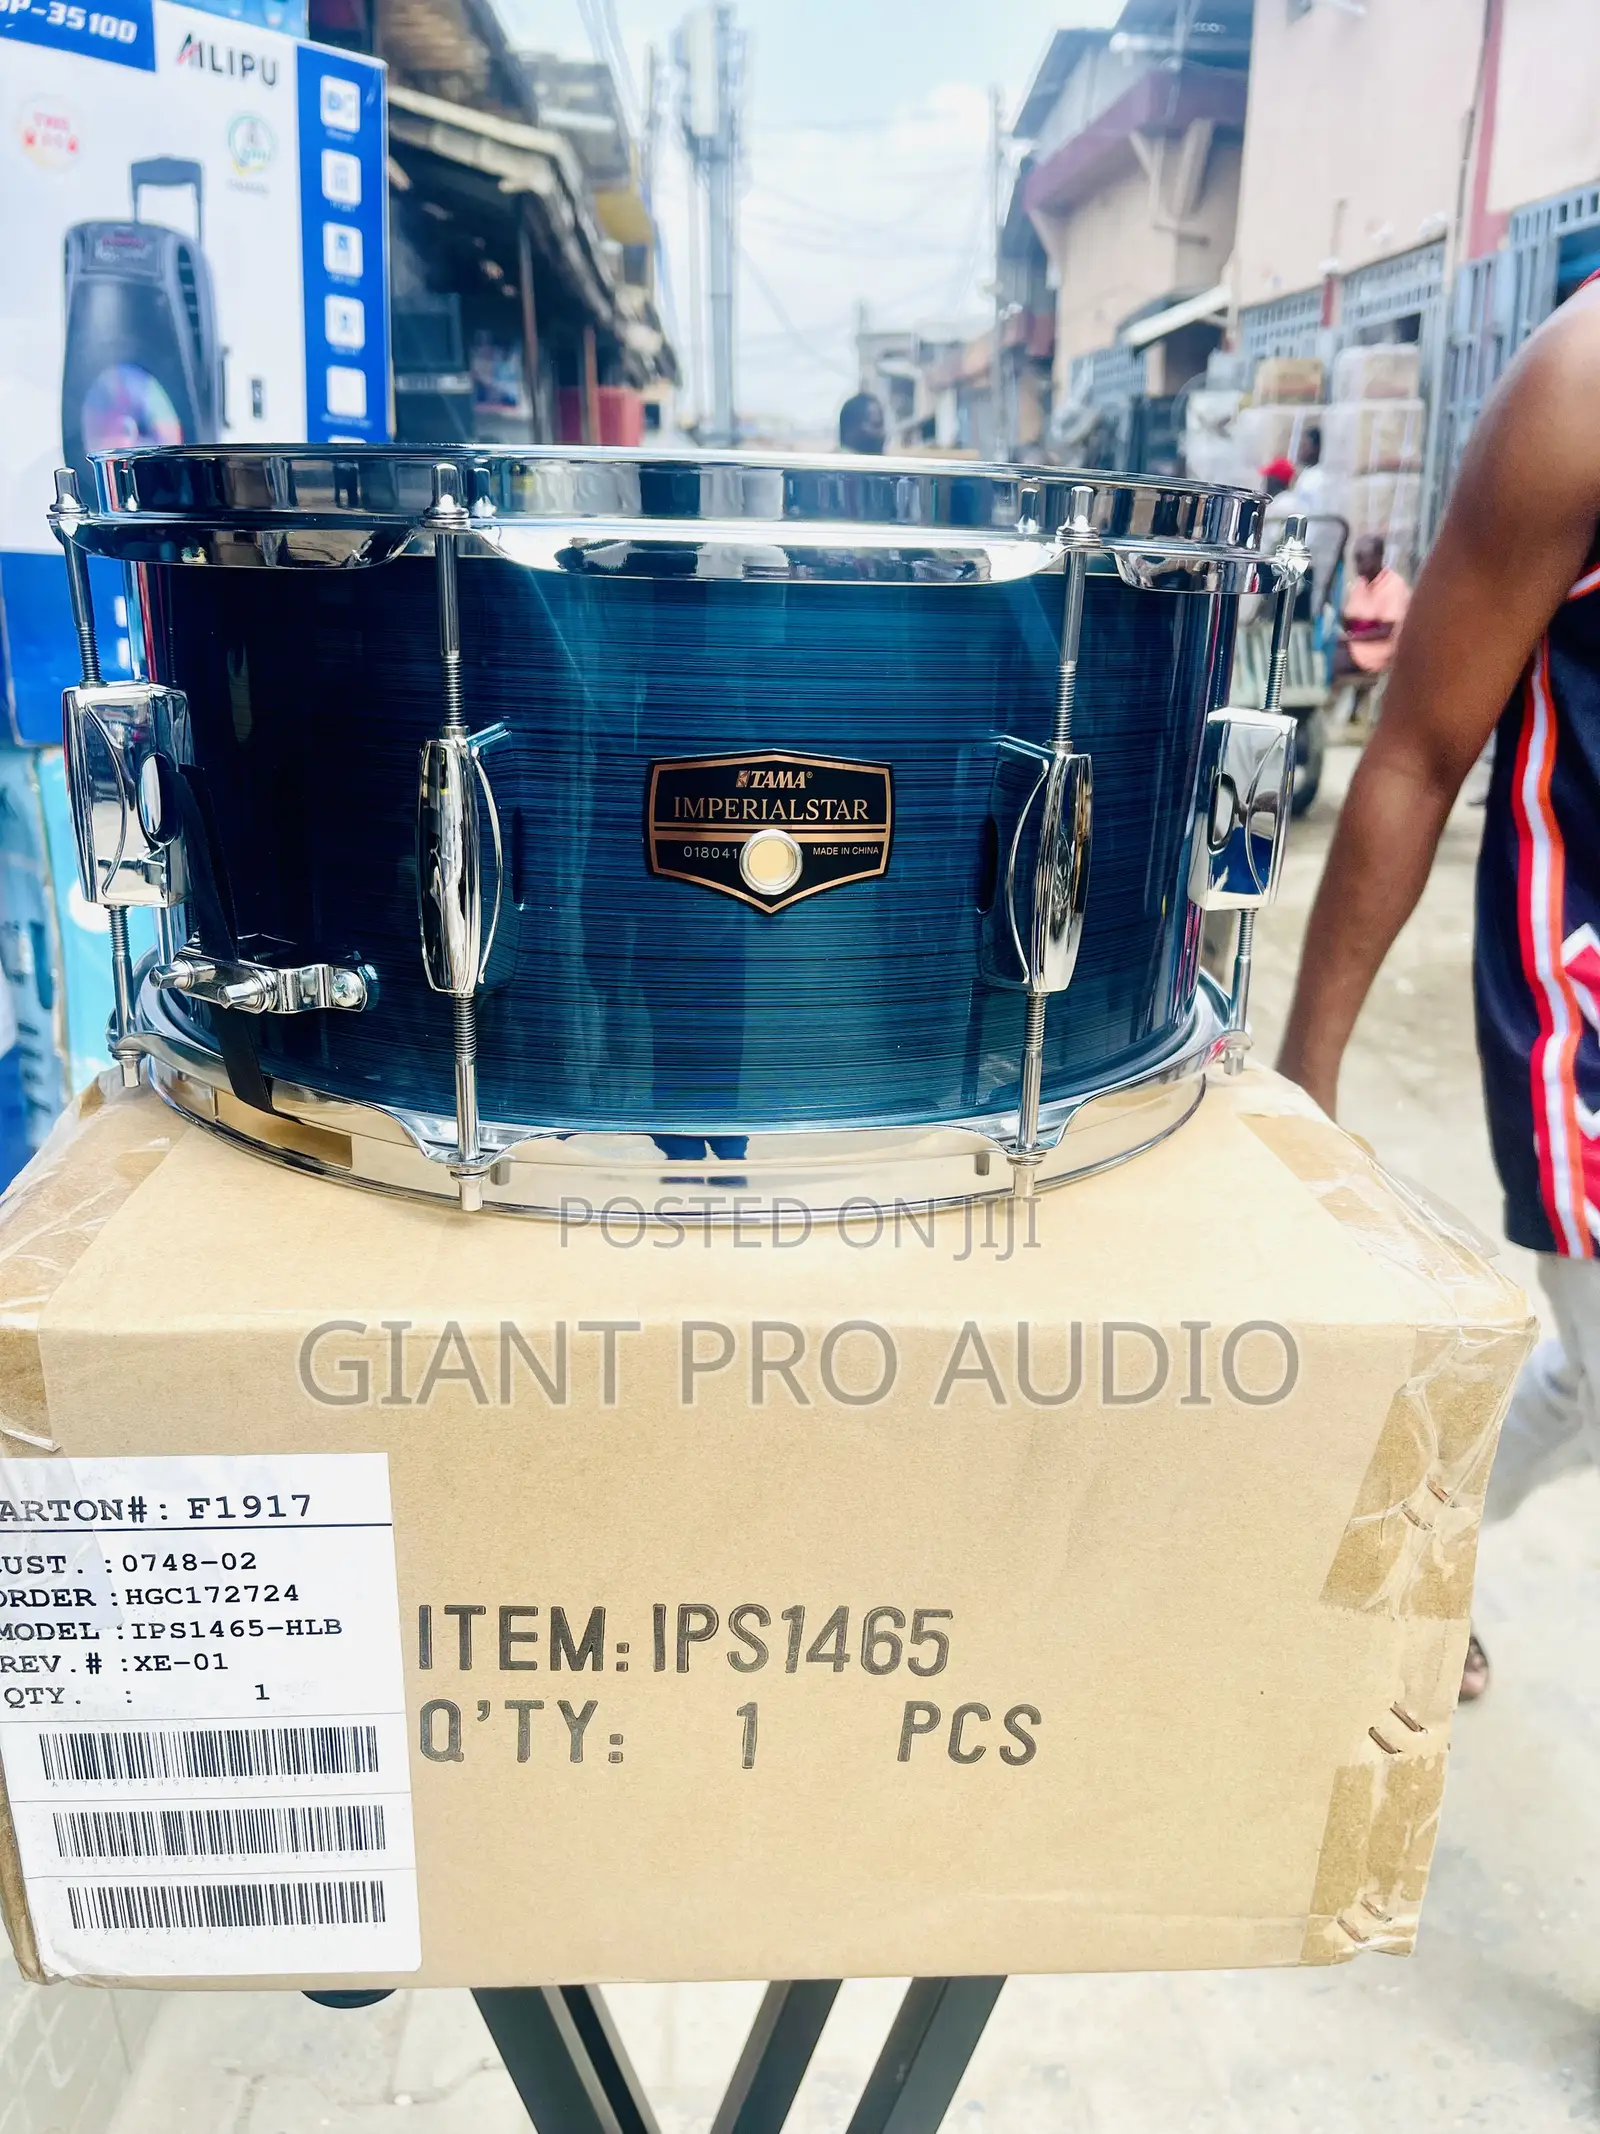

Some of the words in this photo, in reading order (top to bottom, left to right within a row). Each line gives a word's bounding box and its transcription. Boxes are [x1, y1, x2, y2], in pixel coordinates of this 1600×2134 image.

[673, 796, 869, 821] IMPERIALSTAR
[683, 845, 738, 860] 018041
[812, 846, 839, 856] MADE
[840, 846, 850, 855] IN
[851, 846, 879, 855] CHINA
[187, 1494, 310, 1520] F1917
[652, 1603, 954, 1677] IPS1465
[254, 1683, 270, 1701] 1
[736, 1701, 758, 1769] 1
[897, 1700, 1043, 1766] PCS
